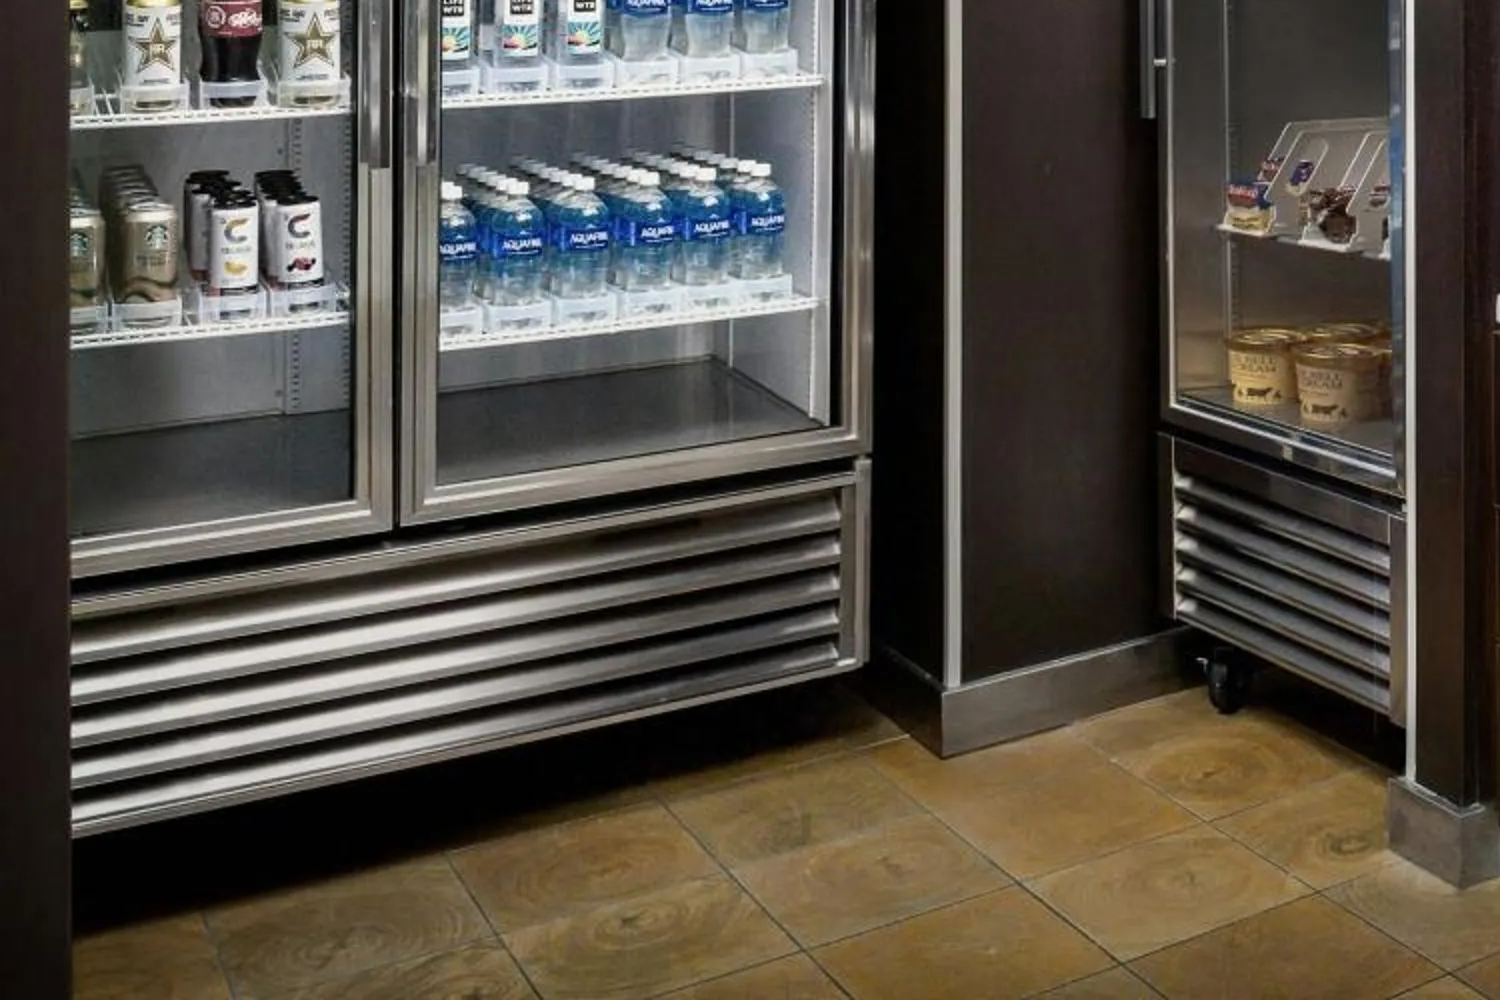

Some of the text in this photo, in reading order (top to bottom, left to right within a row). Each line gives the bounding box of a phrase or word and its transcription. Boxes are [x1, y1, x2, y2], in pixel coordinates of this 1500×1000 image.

[693, 219, 731, 234] AQUAFIN
[502, 237, 543, 251] AQUAFIN
[569, 230, 609, 245] AQUAFIN
[439, 242, 477, 255] AQUAFIN
